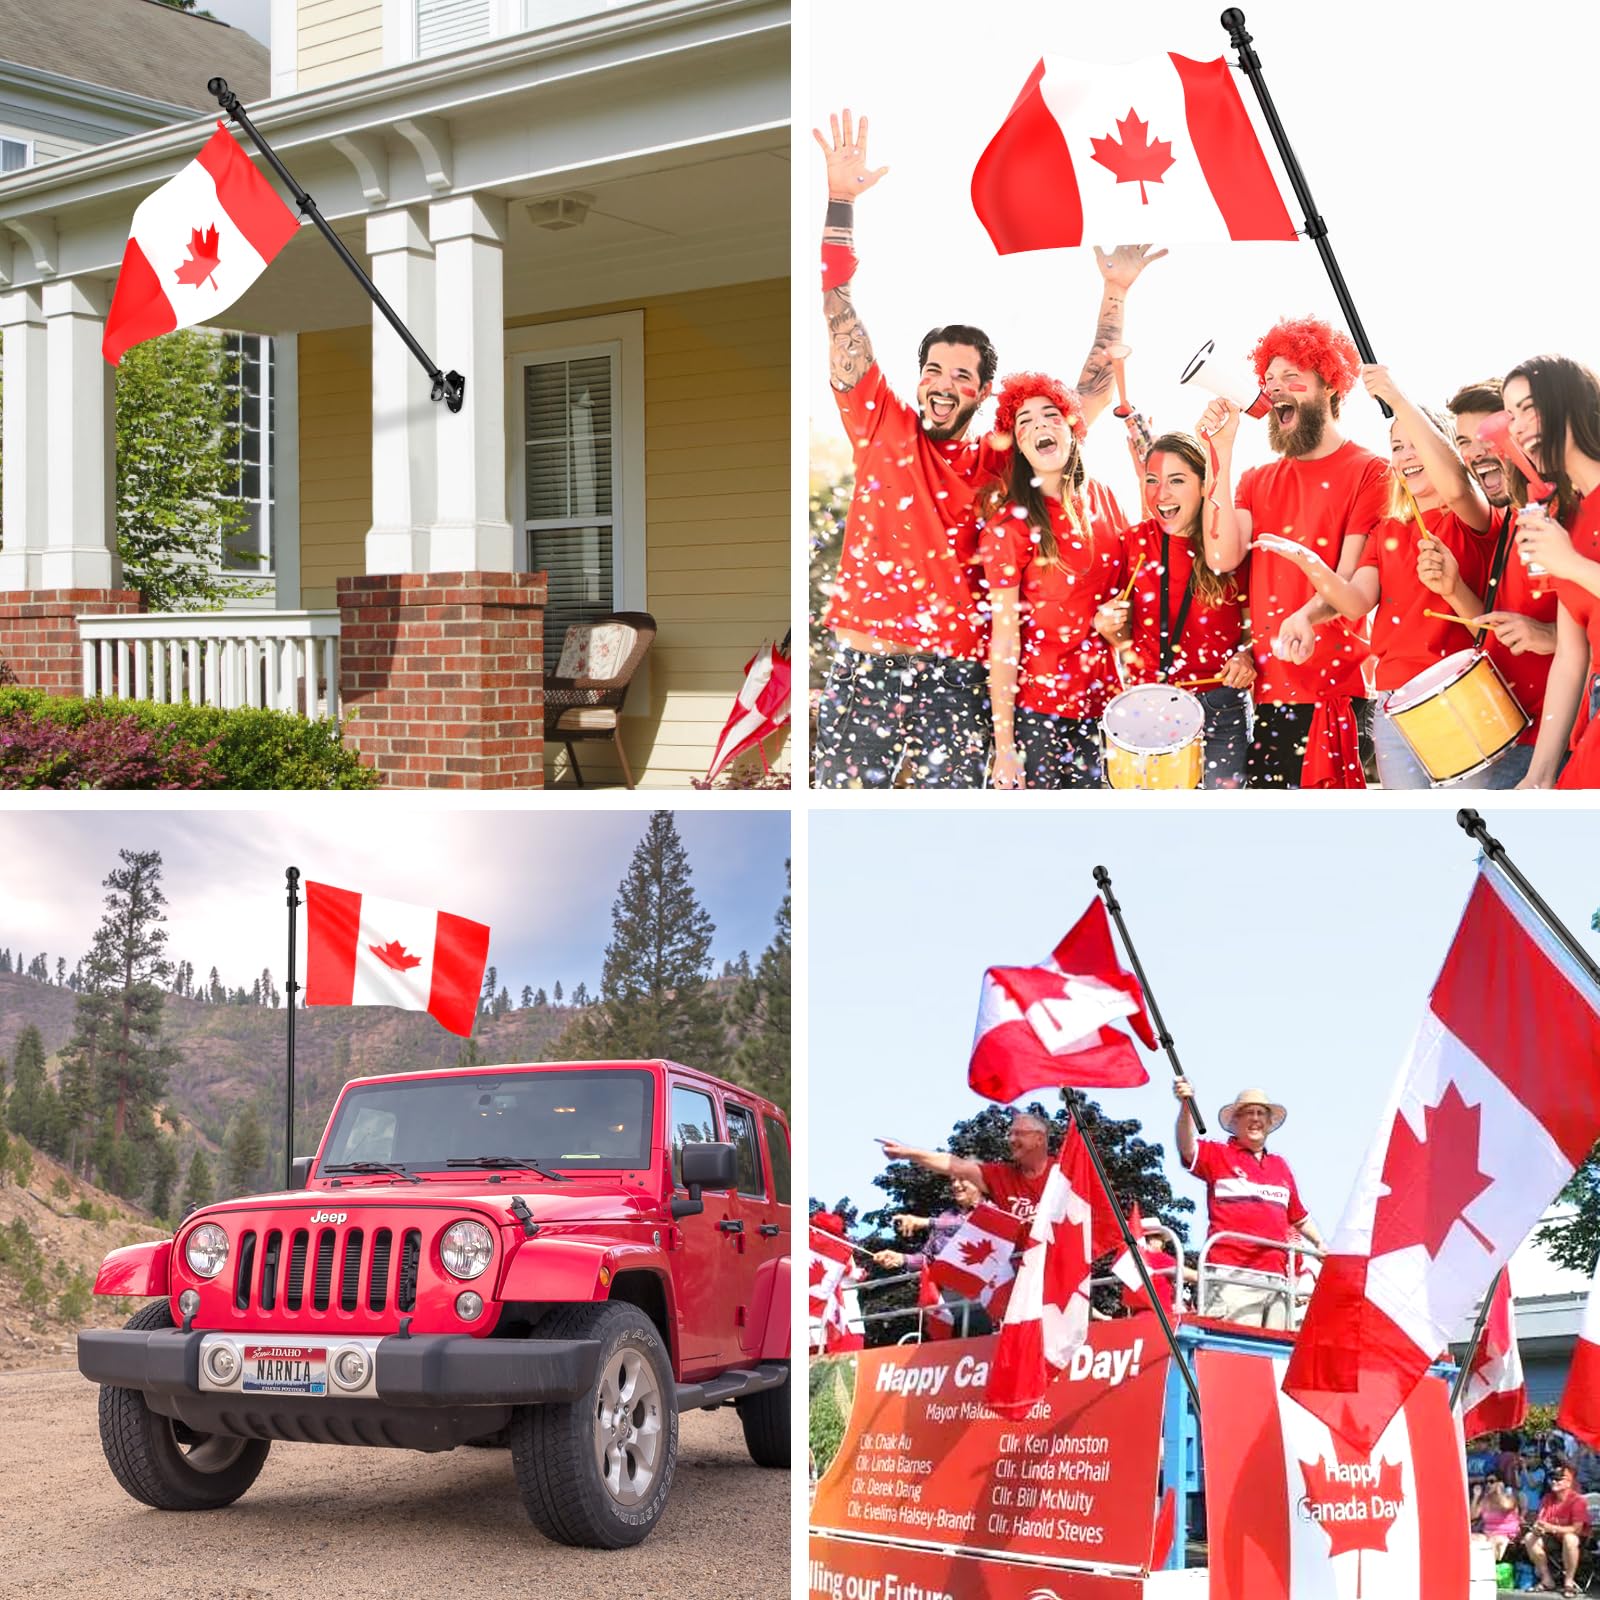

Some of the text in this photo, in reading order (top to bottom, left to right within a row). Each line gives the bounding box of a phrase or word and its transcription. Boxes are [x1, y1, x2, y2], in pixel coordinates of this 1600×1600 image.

[310, 1210, 348, 1225] Jeep
[271, 1348, 302, 1358] IDAHO
[1069, 1338, 1144, 1386] Day!
[256, 1359, 312, 1382] NARNIA
[875, 1362, 949, 1397] Happy
[925, 1403, 957, 1424] Mayor
[875, 1433, 898, 1450] Chak
[898, 1433, 912, 1451] Au
[1000, 1434, 1109, 1457] Cllr. Ken Johnston
[871, 1455, 896, 1473] Linda
[896, 1456, 933, 1475] Barnes
[995, 1459, 1111, 1482] Cllr. Linda McPhail
[1324, 1461, 1380, 1489] Happy
[867, 1477, 895, 1497] Derek
[895, 1479, 922, 1504] Dang
[992, 1486, 1094, 1516] Cllr. Bill McNulty
[863, 1502, 898, 1523] Evelina
[898, 1505, 977, 1531] Halsey-Brandt
[1297, 1494, 1367, 1521] Canada
[987, 1513, 1105, 1545] Cllr. Harold Steves
[845, 1575, 881, 1600] our
